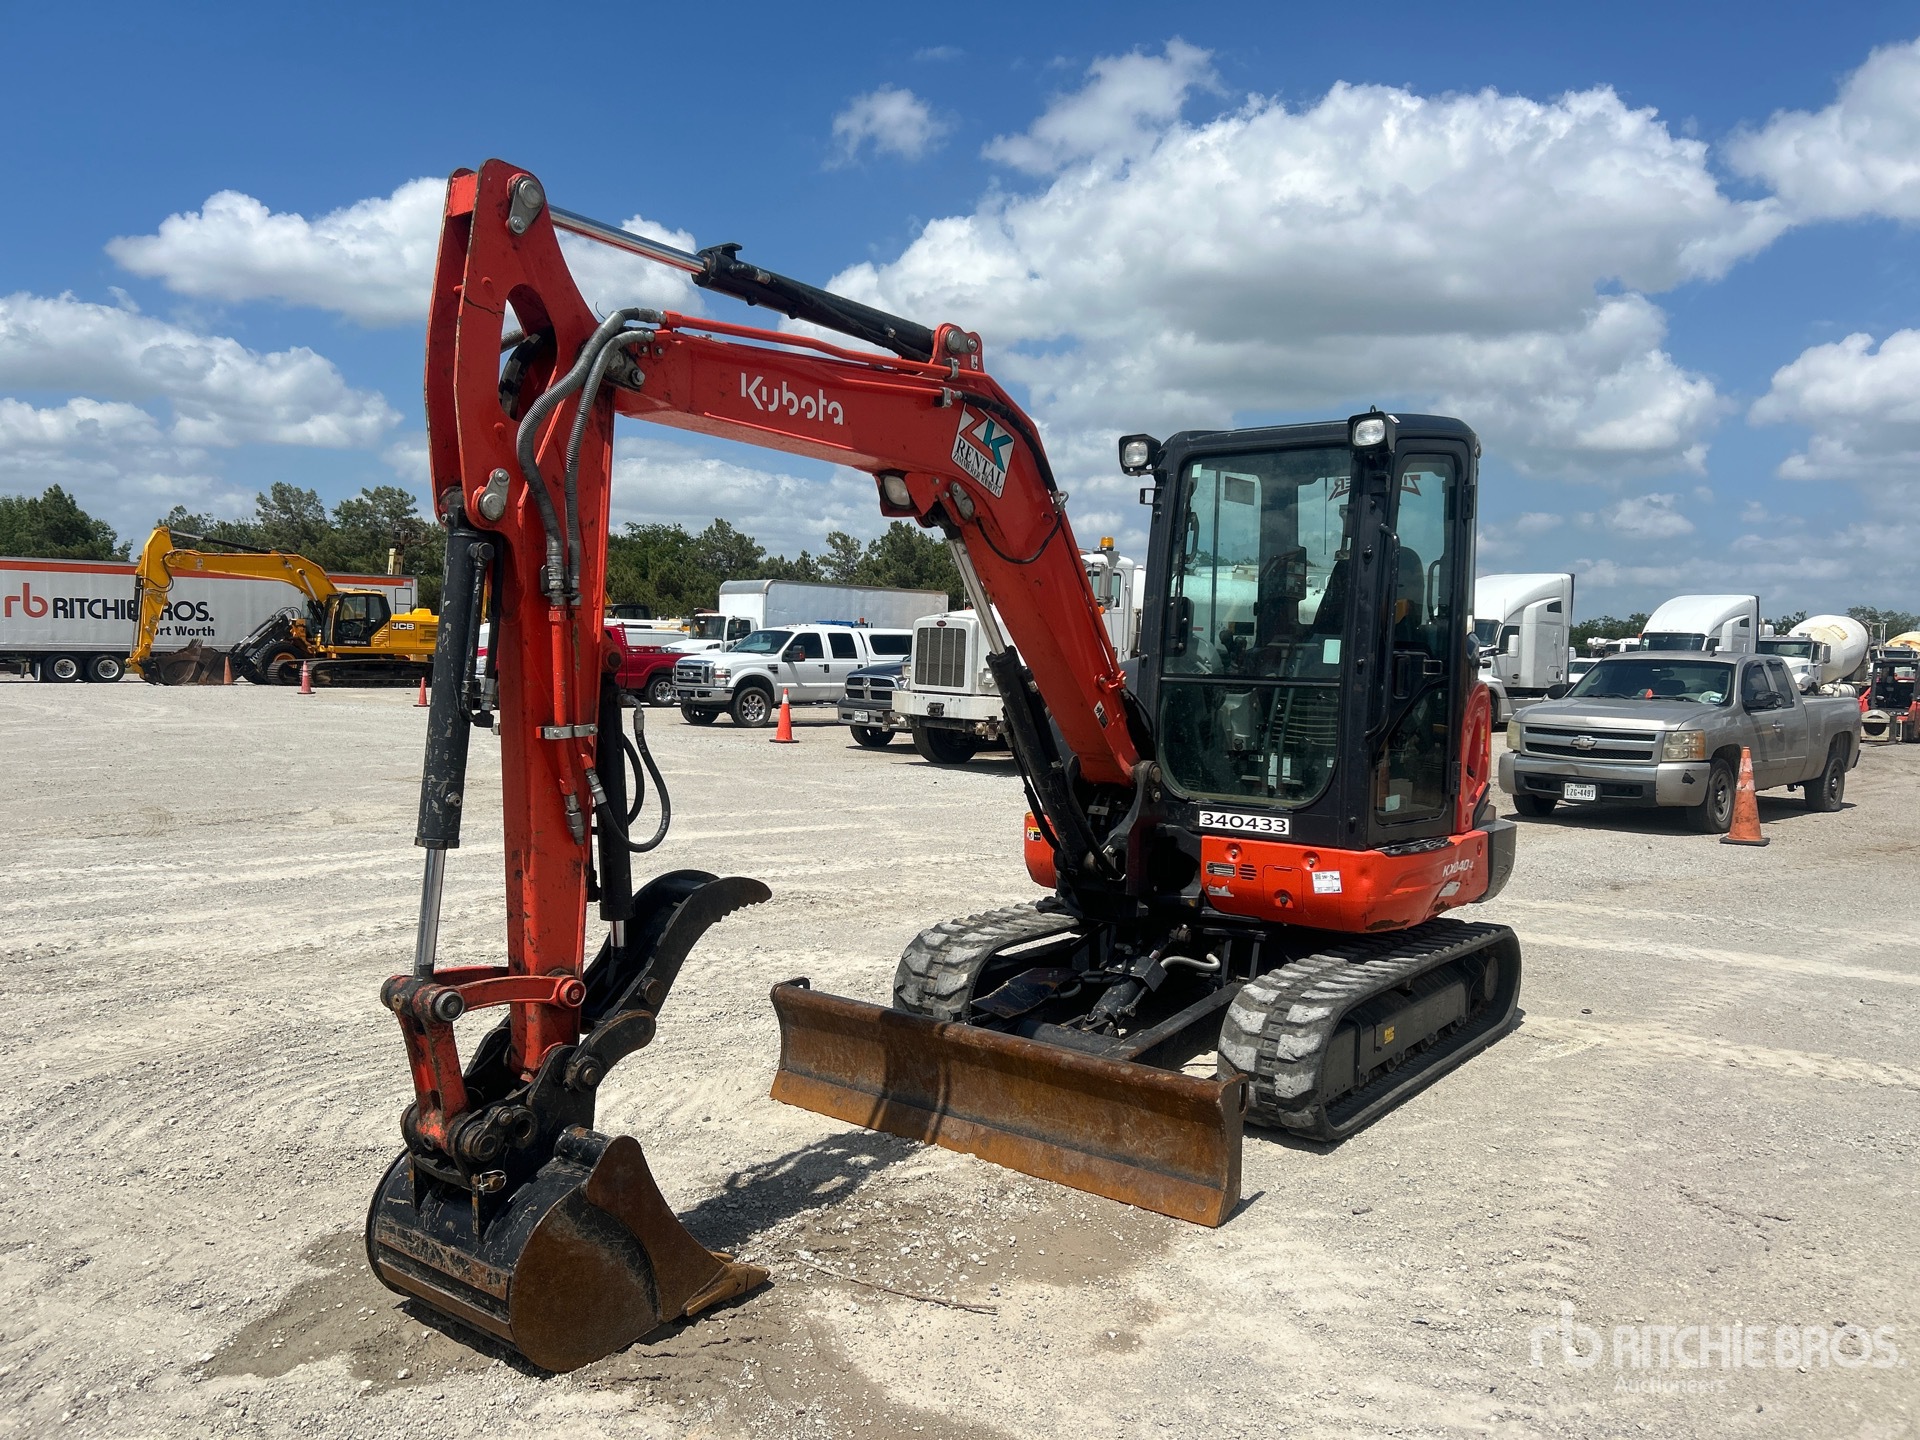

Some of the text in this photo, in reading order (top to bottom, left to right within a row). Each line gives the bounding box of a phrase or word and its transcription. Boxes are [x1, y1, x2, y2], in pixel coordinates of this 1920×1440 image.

[741, 372, 843, 425] Kubota
[956, 437, 1003, 489] RENTAL
[977, 475, 1001, 497] KUBOTA
[160, 601, 214, 622] ROS.
[175, 626, 215, 636] Worth
[391, 622, 415, 630] JCB
[1201, 812, 1286, 833] 340433
